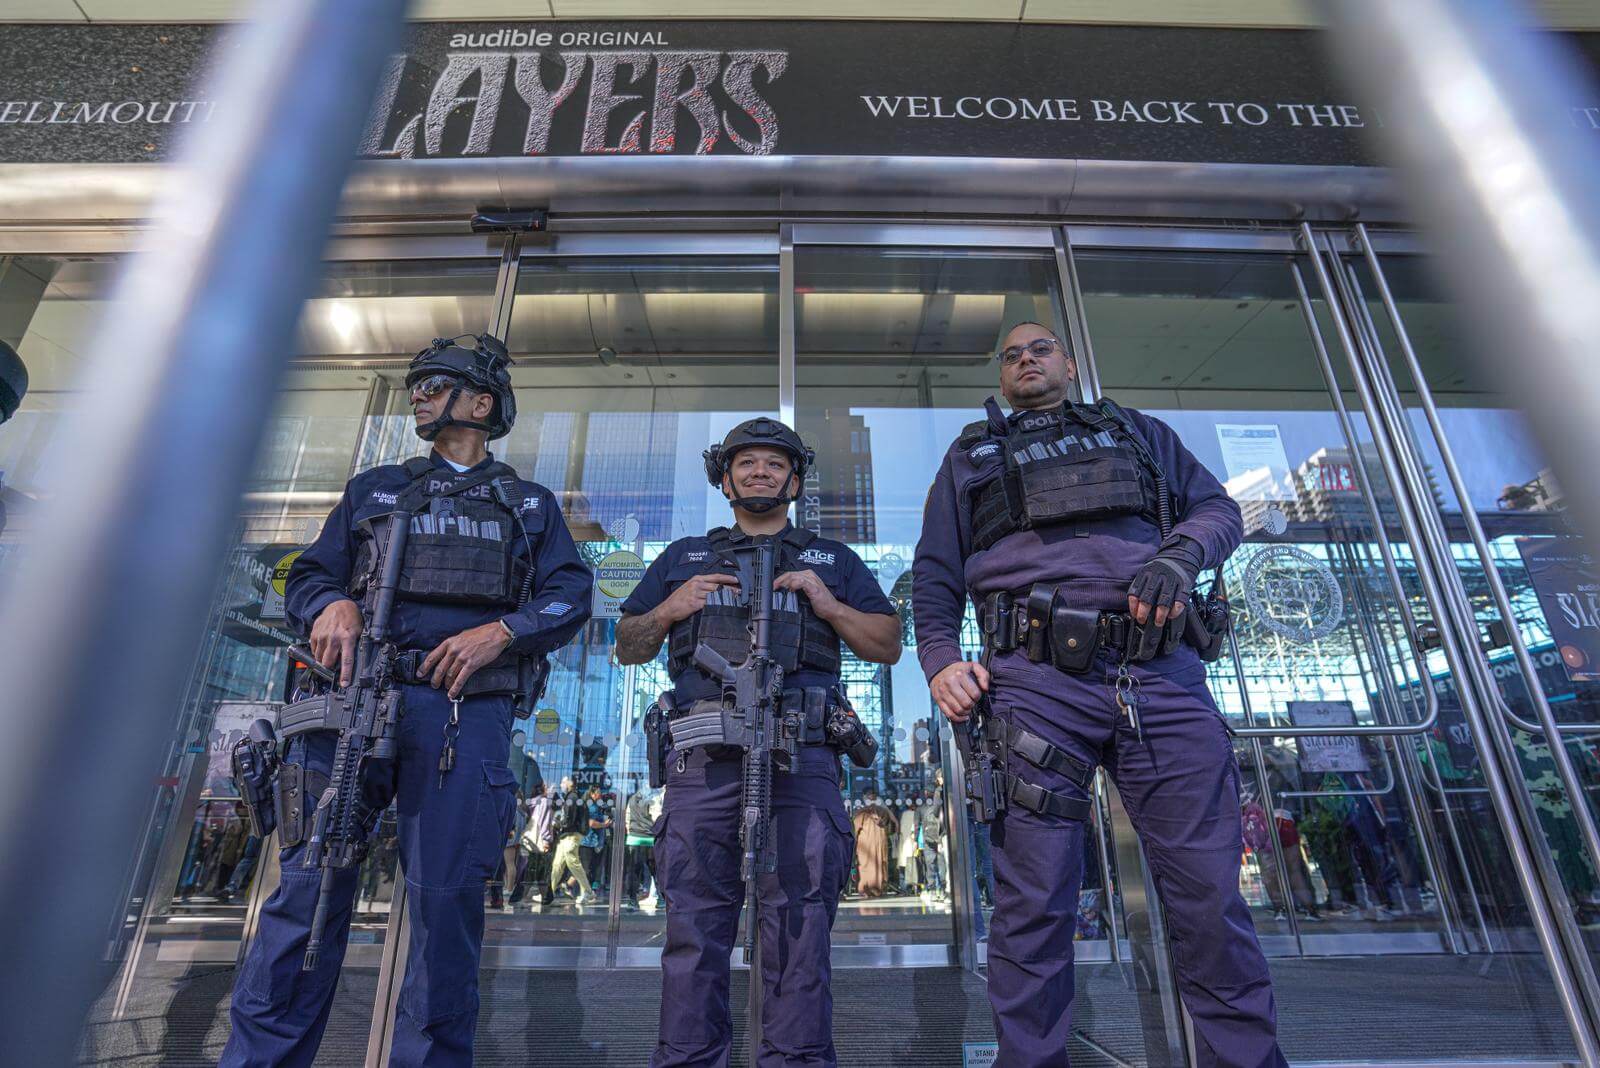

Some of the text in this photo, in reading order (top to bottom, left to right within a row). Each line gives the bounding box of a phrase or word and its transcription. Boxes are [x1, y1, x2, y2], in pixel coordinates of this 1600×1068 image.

[449, 29, 669, 47] audible ORIGINAL
[0, 101, 215, 123] ELLMOUT
[860, 96, 1081, 121] WELCOME
[1091, 100, 1203, 124] BACK
[1208, 102, 1269, 126] TO
[1277, 103, 1364, 128] THE
[601, 570, 640, 578] CAUTION
[237, 611, 270, 635] Random
